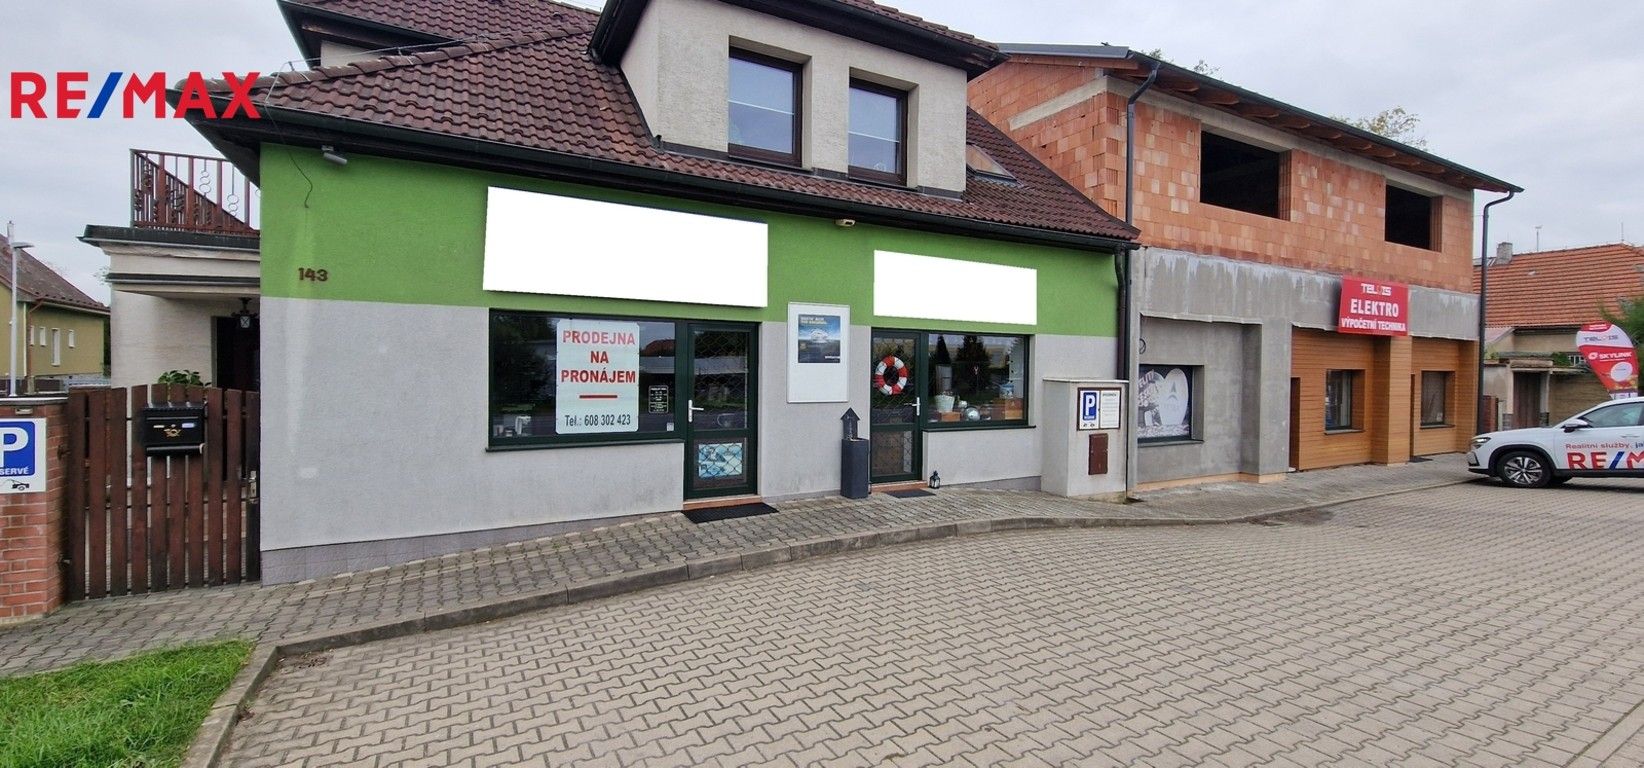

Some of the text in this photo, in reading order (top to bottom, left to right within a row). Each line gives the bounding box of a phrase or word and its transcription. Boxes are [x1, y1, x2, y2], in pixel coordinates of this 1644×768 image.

[298, 268, 328, 283] 143
[1350, 299, 1399, 317] ELEKTRO
[1341, 316, 1406, 331] VÝPOČETNÍ TECHNIKA
[562, 330, 636, 345] PRODEJNA
[590, 351, 609, 364] NA
[561, 367, 636, 383] PRONÁJEM
[1085, 395, 1096, 416] P
[565, 414, 631, 426] Tel.: 608 302 423
